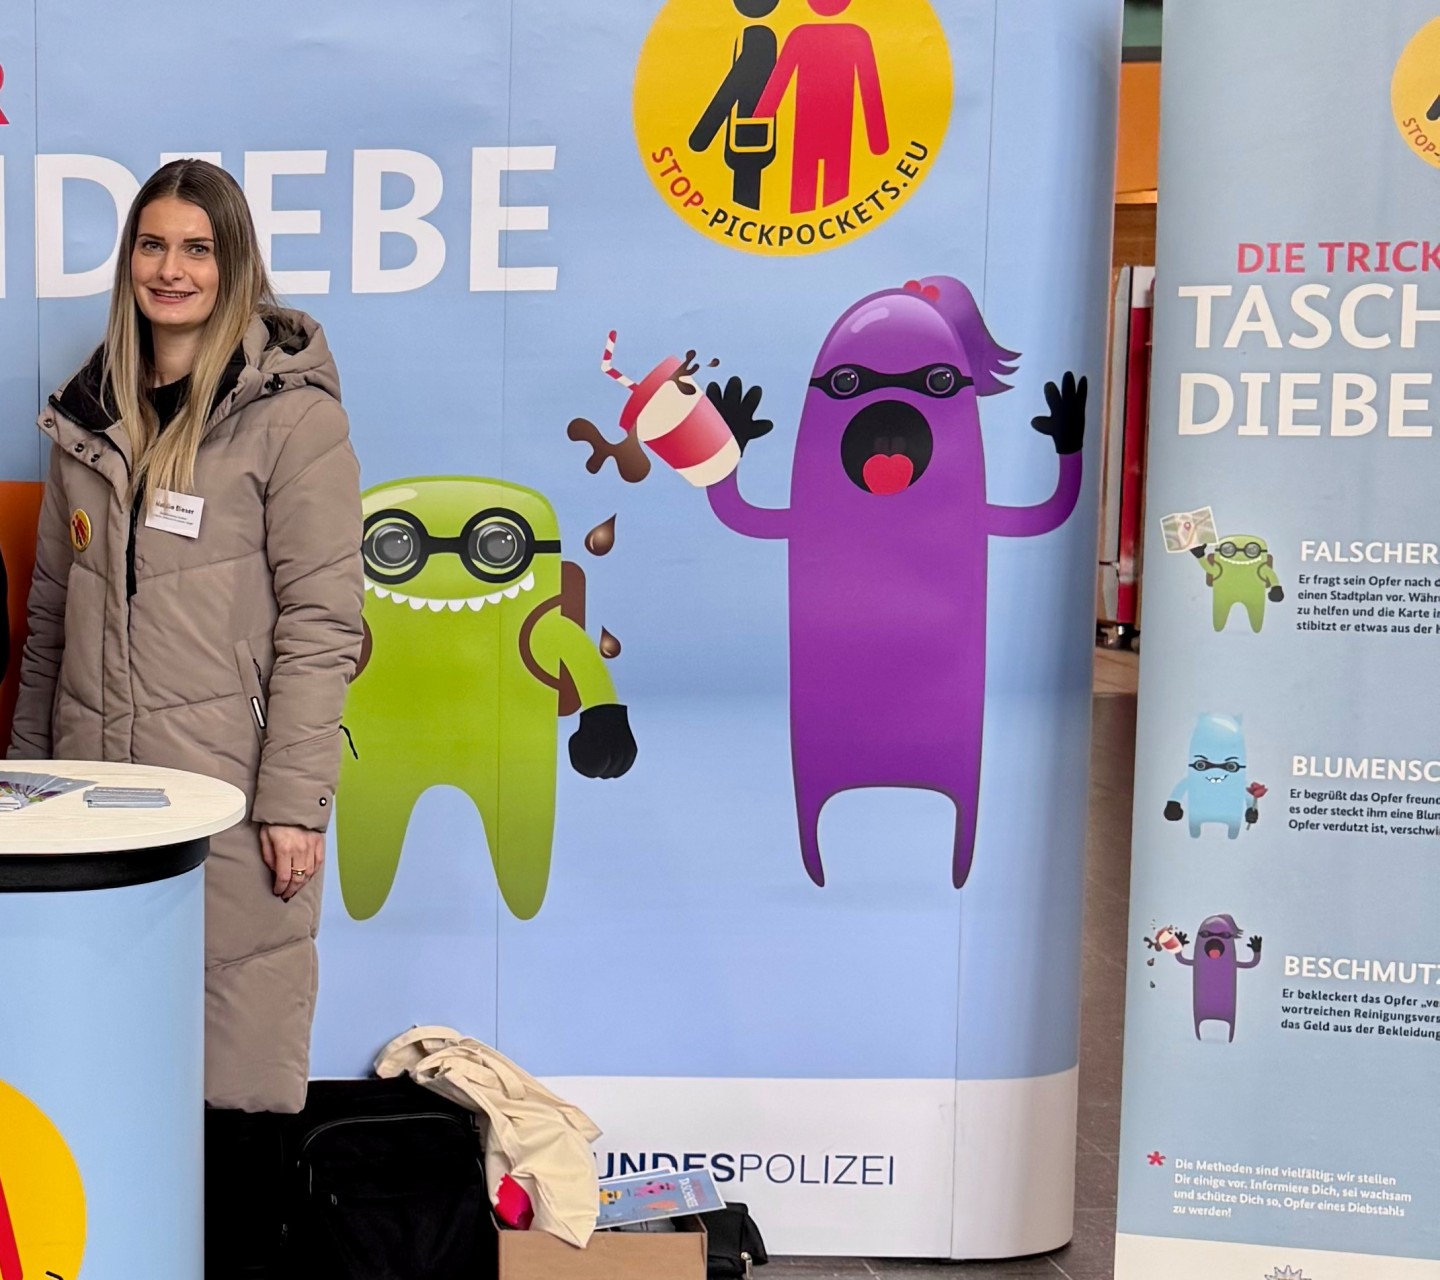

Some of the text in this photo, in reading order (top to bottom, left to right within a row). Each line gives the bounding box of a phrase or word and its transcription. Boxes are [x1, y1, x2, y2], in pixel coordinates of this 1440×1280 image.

[651, 140, 929, 247] STOP-PICKPOCKETS.EU
[1237, 242, 1306, 274] DIE
[1178, 283, 1440, 349] TASCH
[1177, 372, 1433, 438] DIEBE
[1301, 540, 1440, 565] FALSCHER
[1298, 574, 1431, 588] Er fragt sein Opfer nach
[1298, 590, 1406, 603] einen Stadtplan vor.
[1292, 755, 1440, 782] BLUMENSC
[1290, 788, 1403, 805] Er begrüßt das Opfer
[593, 1152, 894, 1185] UNDESPOLIZEI
[1175, 1158, 1397, 1186] Die Methoden sind vielfältig; wir stellen
